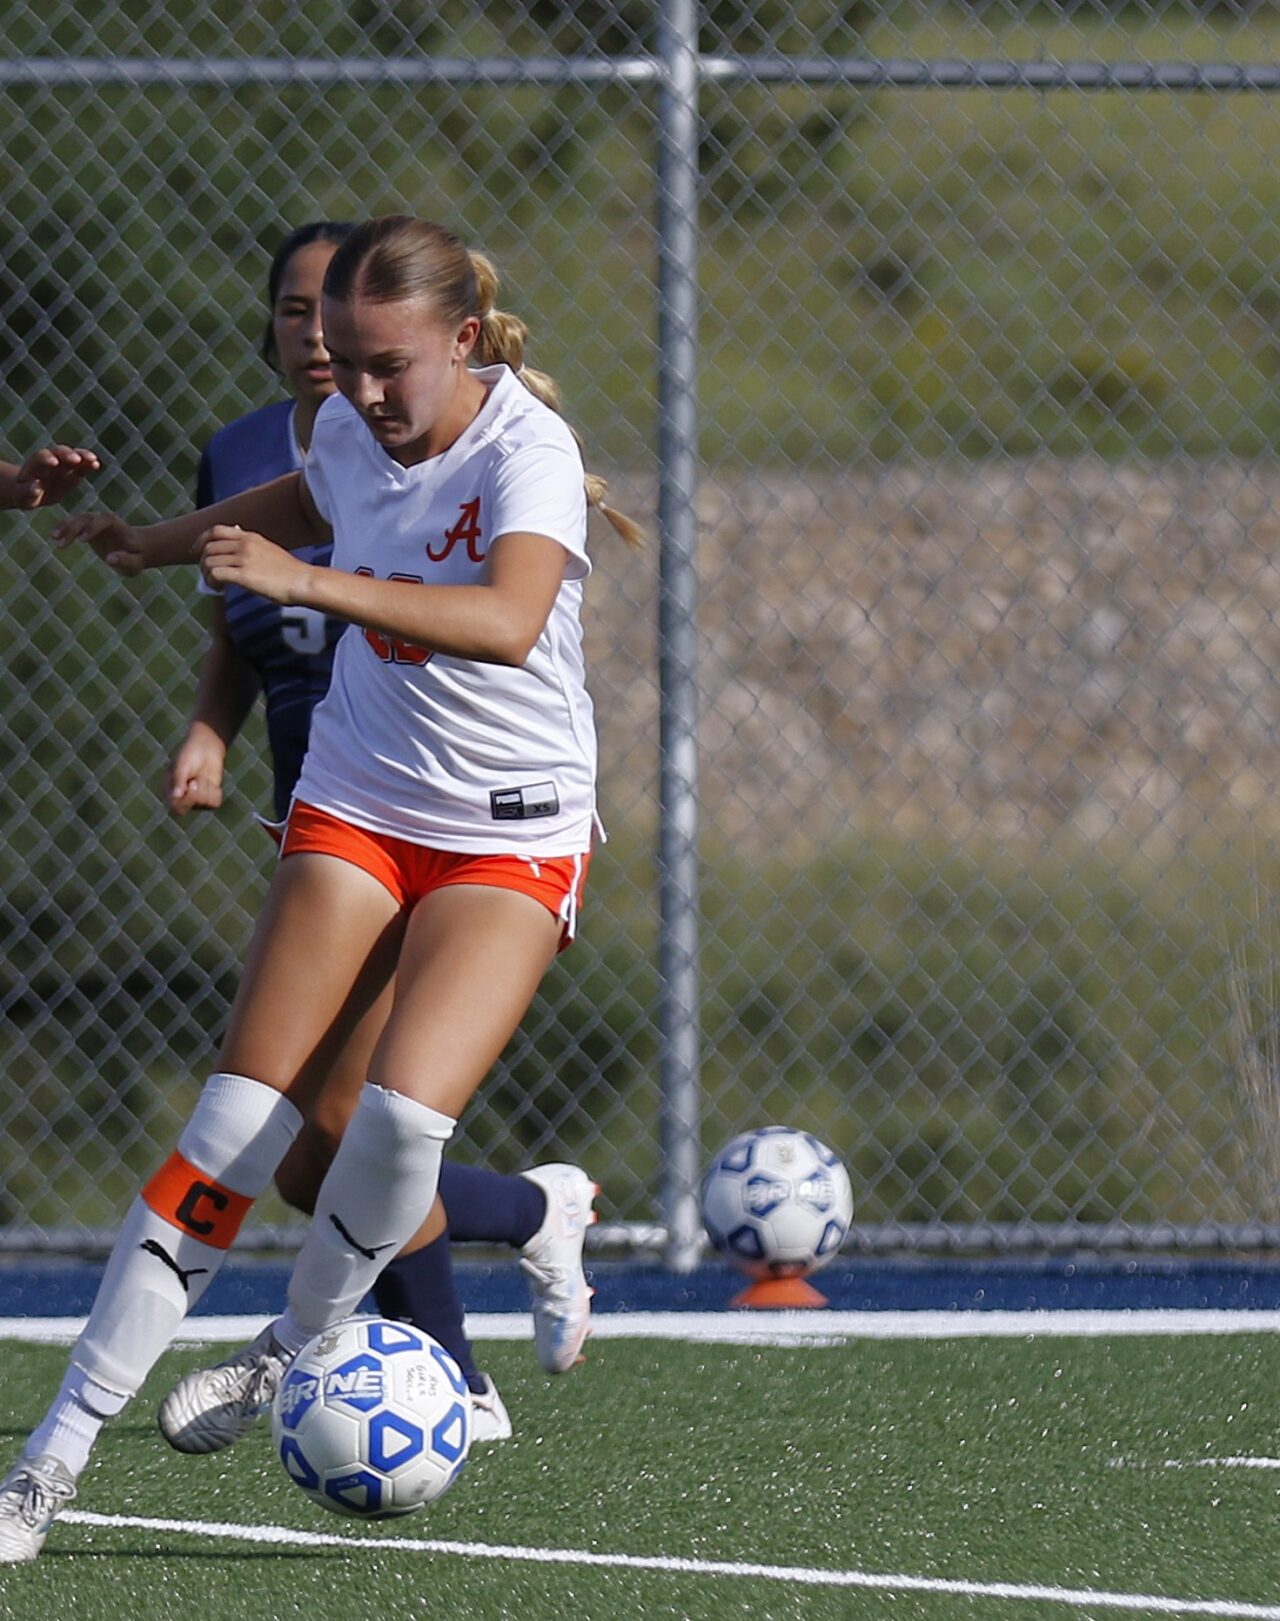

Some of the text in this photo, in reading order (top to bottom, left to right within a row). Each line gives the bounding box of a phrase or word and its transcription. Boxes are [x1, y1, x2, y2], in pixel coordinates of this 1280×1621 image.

[427, 496, 486, 563] A
[532, 802, 552, 814] XS
[175, 1180, 229, 1235] C
[280, 1369, 386, 1411] BRINE
